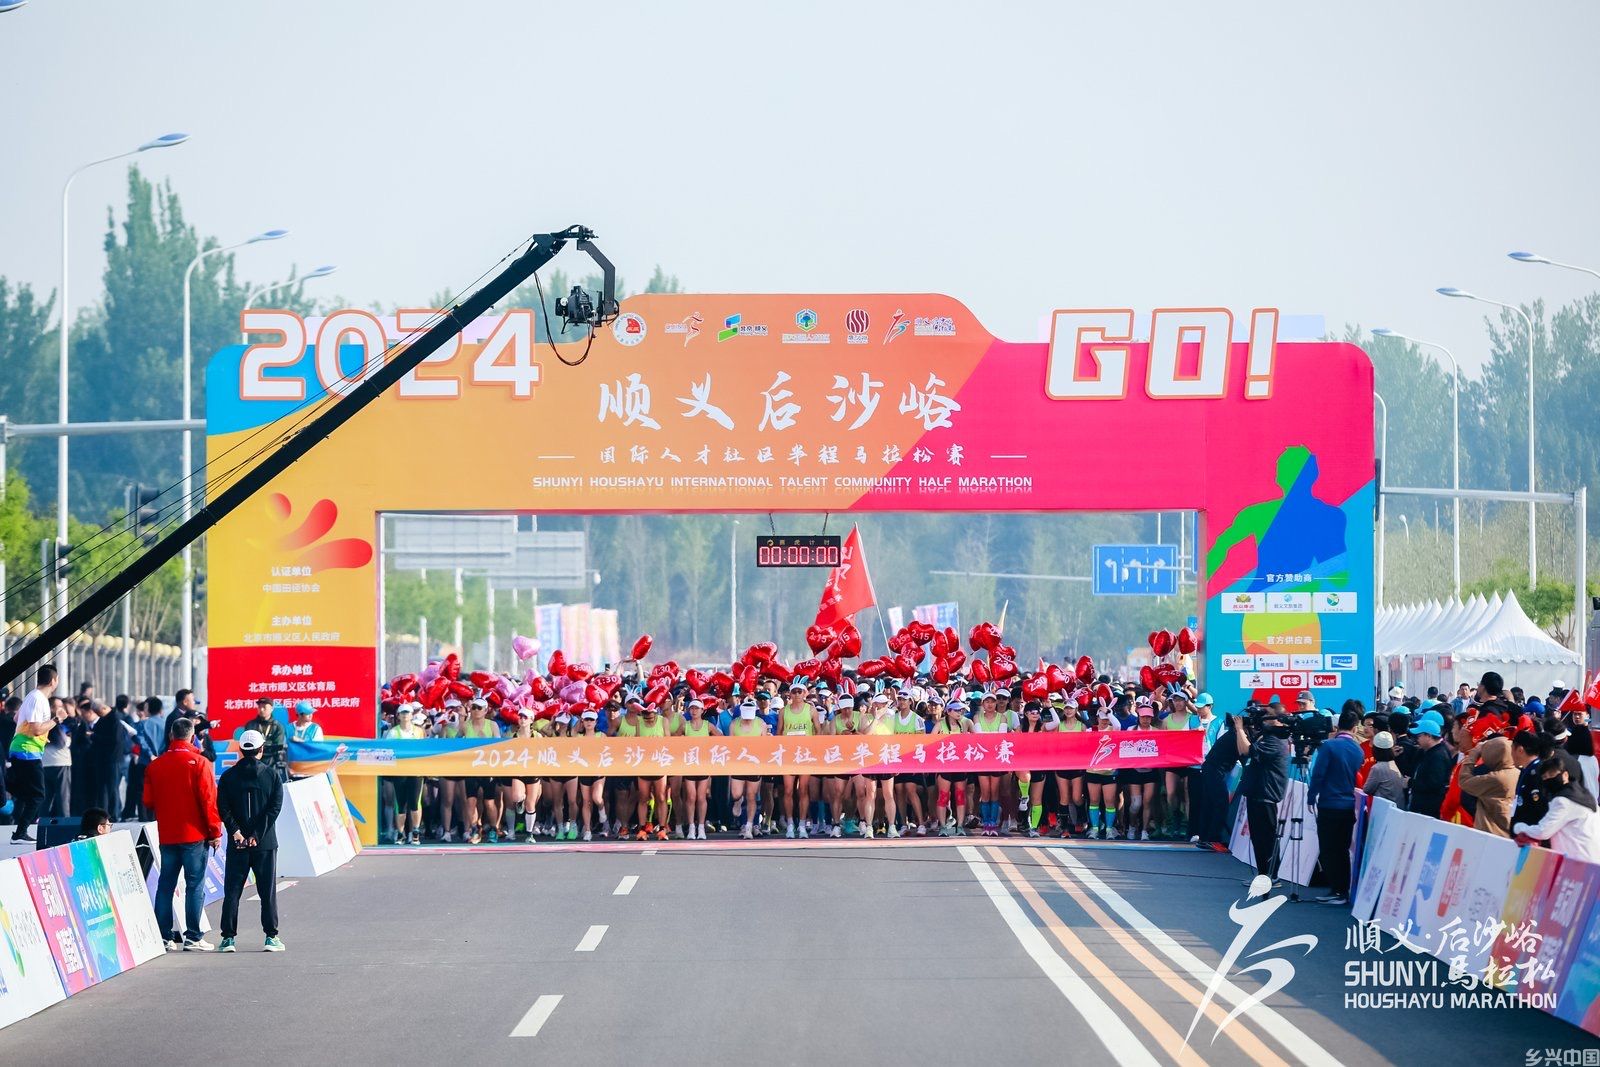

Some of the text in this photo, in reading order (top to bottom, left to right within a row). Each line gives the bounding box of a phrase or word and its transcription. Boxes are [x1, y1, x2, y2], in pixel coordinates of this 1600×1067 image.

[240, 309, 541, 400] 2024
[1044, 307, 1279, 400] GO!
[598, 370, 962, 433] 顺义后沙峪
[599, 443, 966, 467] 国际人才社区半程马拉松赛
[533, 477, 1033, 487] SHUNYI HOUSHAYU INTERNATIONAL TALENT COMMUNITY HALF MARATHON
[760, 546, 838, 565] 00:00:00
[272, 567, 312, 577] 认证单位
[1266, 574, 1312, 583] 官方赞助商
[263, 584, 320, 593] 中国田径协会
[272, 616, 312, 626] 主办单位
[244, 632, 340, 643] 北京市顺义区人民政府
[912, 629, 930, 641] 2:15
[1266, 636, 1312, 645] 官方供应商
[271, 664, 313, 676] 承办单位
[249, 681, 336, 693] 北京市顺义区体育局
[597, 676, 618, 686] 1:30
[1028, 676, 1046, 692] 2:30
